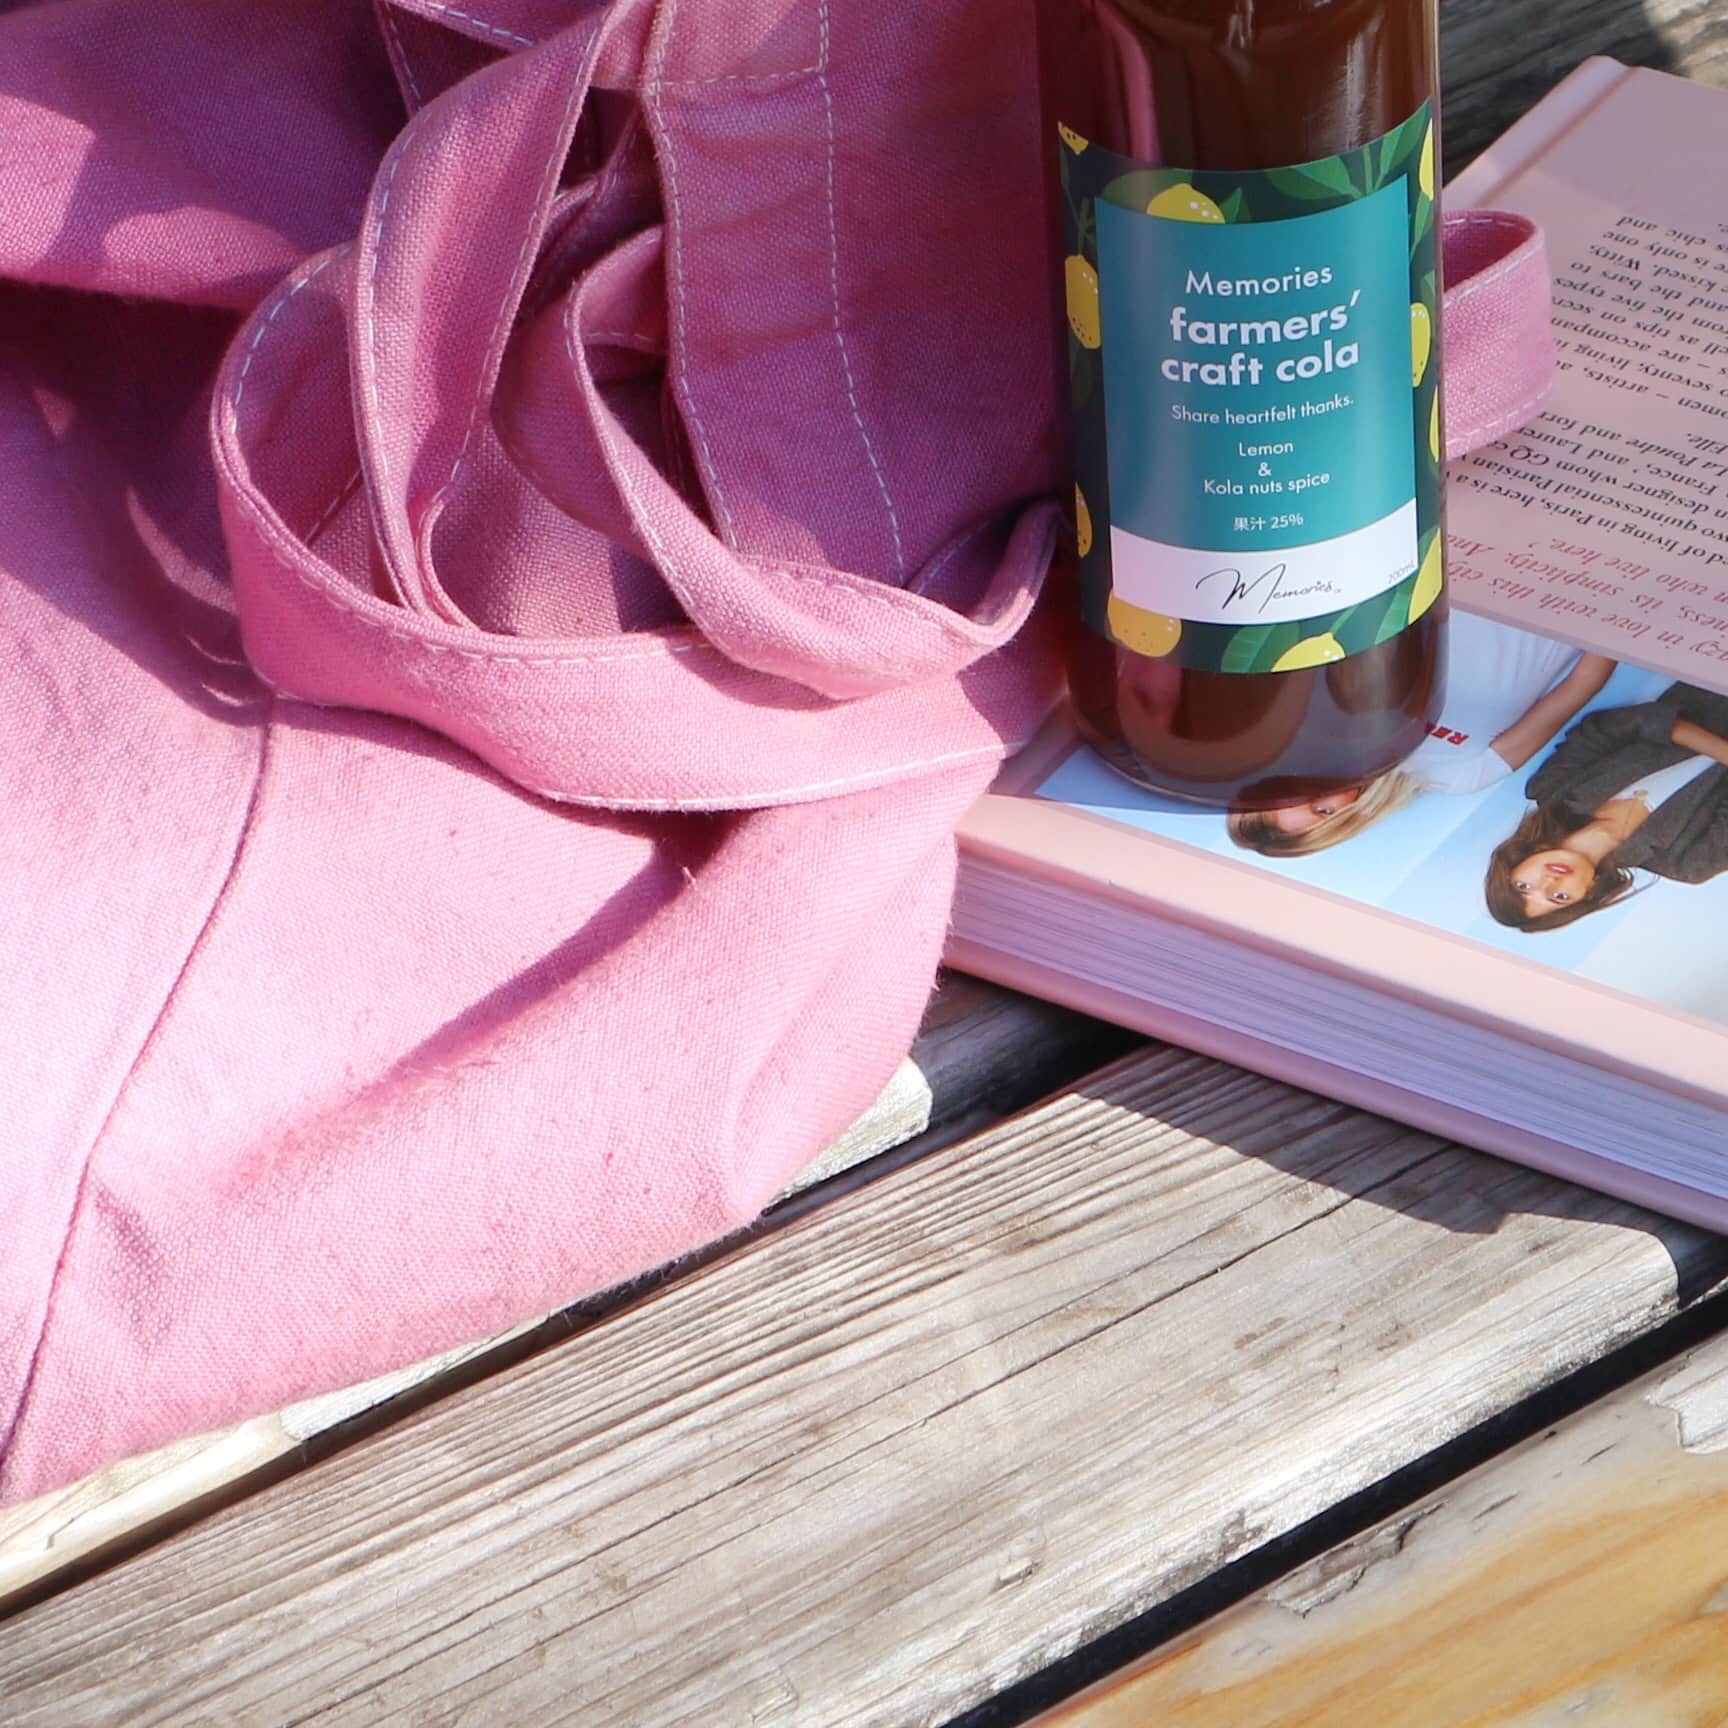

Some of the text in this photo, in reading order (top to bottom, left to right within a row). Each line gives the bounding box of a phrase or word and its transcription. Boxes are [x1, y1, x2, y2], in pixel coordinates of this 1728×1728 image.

[1185, 266, 1333, 296] Memories
[1600, 311, 1627, 324] on
[1634, 321, 1671, 338] tips
[1679, 334, 1700, 345] as
[1161, 339, 1359, 386] craft cola
[1171, 393, 1354, 424] Share heartfelt thanks.
[1578, 424, 1622, 440] and
[1238, 441, 1294, 457] Lemon
[1509, 445, 1550, 466] GQ
[1586, 448, 1630, 465] and
[1625, 439, 1699, 467] Poudre
[1257, 462, 1272, 477] &
[1456, 474, 1469, 482] a
[1472, 457, 1554, 490] Parisian
[1555, 460, 1618, 485] whom
[1204, 472, 1330, 495] Kola nuts spice
[1471, 479, 1488, 493] is
[1489, 485, 1535, 508] here
[1552, 482, 1698, 531] quintessential
[1622, 482, 1710, 515] designer
[1233, 512, 1304, 532] 果汁 25%
[1597, 517, 1618, 533] in
[1620, 523, 1679, 552] living
[1677, 545, 1706, 557] of
[1604, 557, 1651, 581] live
[1487, 577, 1536, 600] this
[1655, 573, 1709, 596] who
[1539, 593, 1598, 618] with
[1629, 594, 1664, 614] its
[1600, 613, 1652, 639] love
[1656, 630, 1685, 649] in
